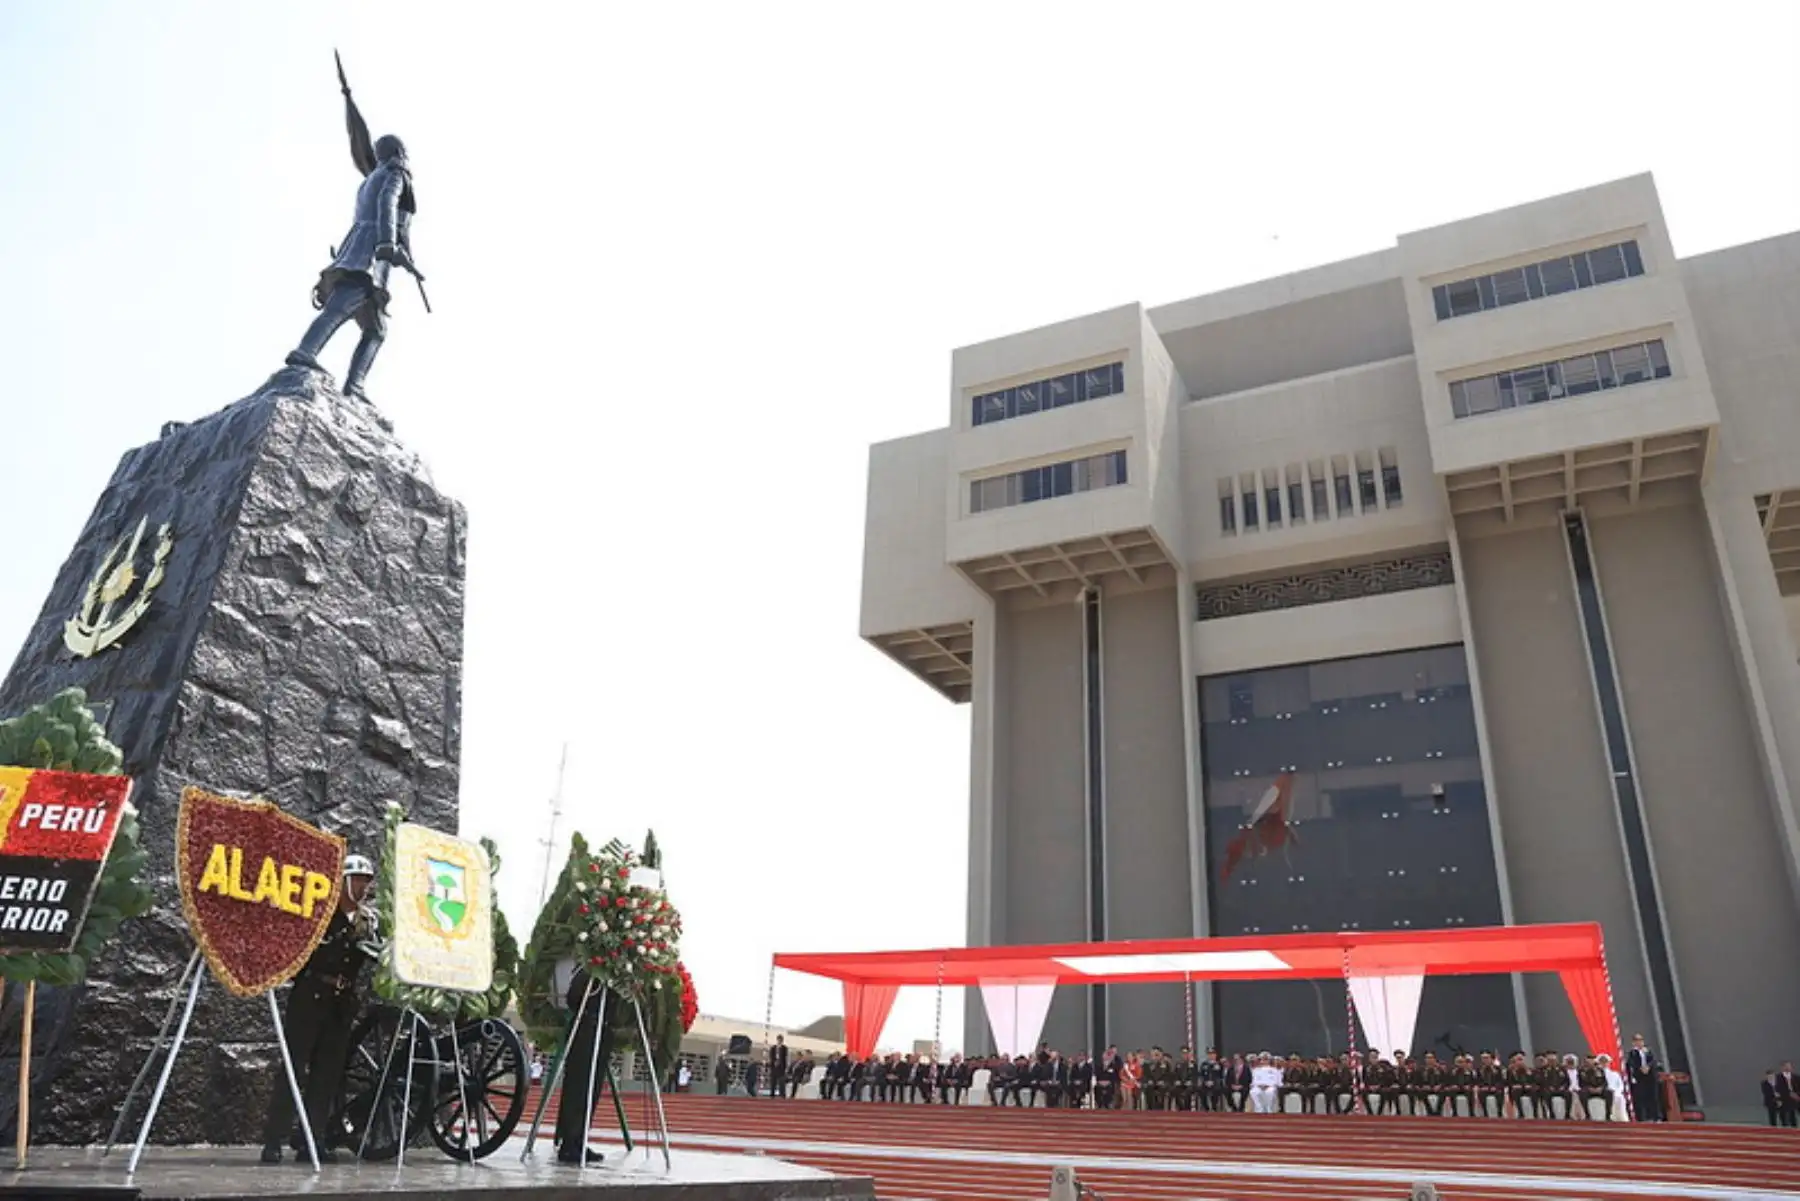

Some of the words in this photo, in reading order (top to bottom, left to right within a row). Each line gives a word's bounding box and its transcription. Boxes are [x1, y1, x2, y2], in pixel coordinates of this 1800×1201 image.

[19, 800, 107, 833] PERÚ
[0, 875, 68, 902] ERIO
[197, 844, 332, 918] ALAEP
[0, 905, 70, 933] RIOR
